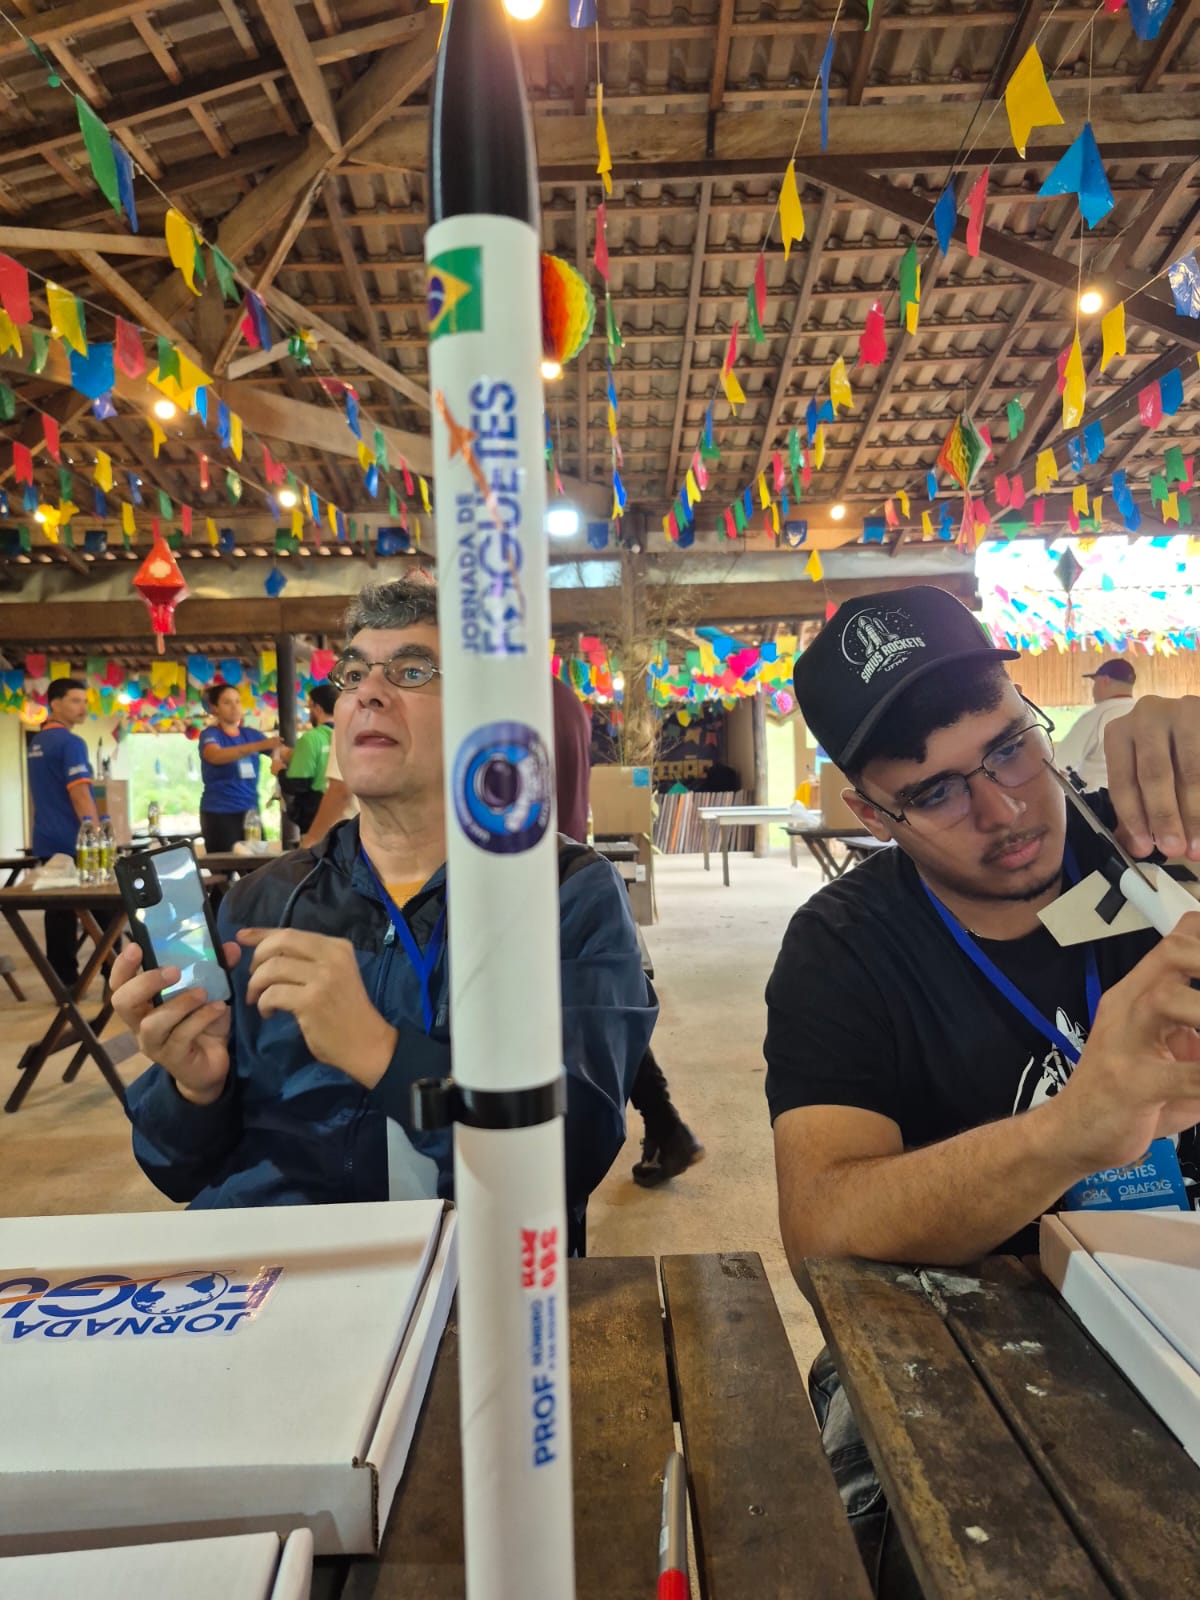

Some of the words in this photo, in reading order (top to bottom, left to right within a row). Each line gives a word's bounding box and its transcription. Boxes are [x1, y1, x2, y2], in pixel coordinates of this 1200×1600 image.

[456, 494, 475, 523] DE
[470, 381, 525, 655] FOGUETES
[459, 532, 481, 654] JORNADA
[861, 651, 884, 684] SIRIUS
[881, 636, 926, 656] ROCKETS
[13, 1312, 252, 1339] JORNADA
[533, 1374, 556, 1468] PROF
